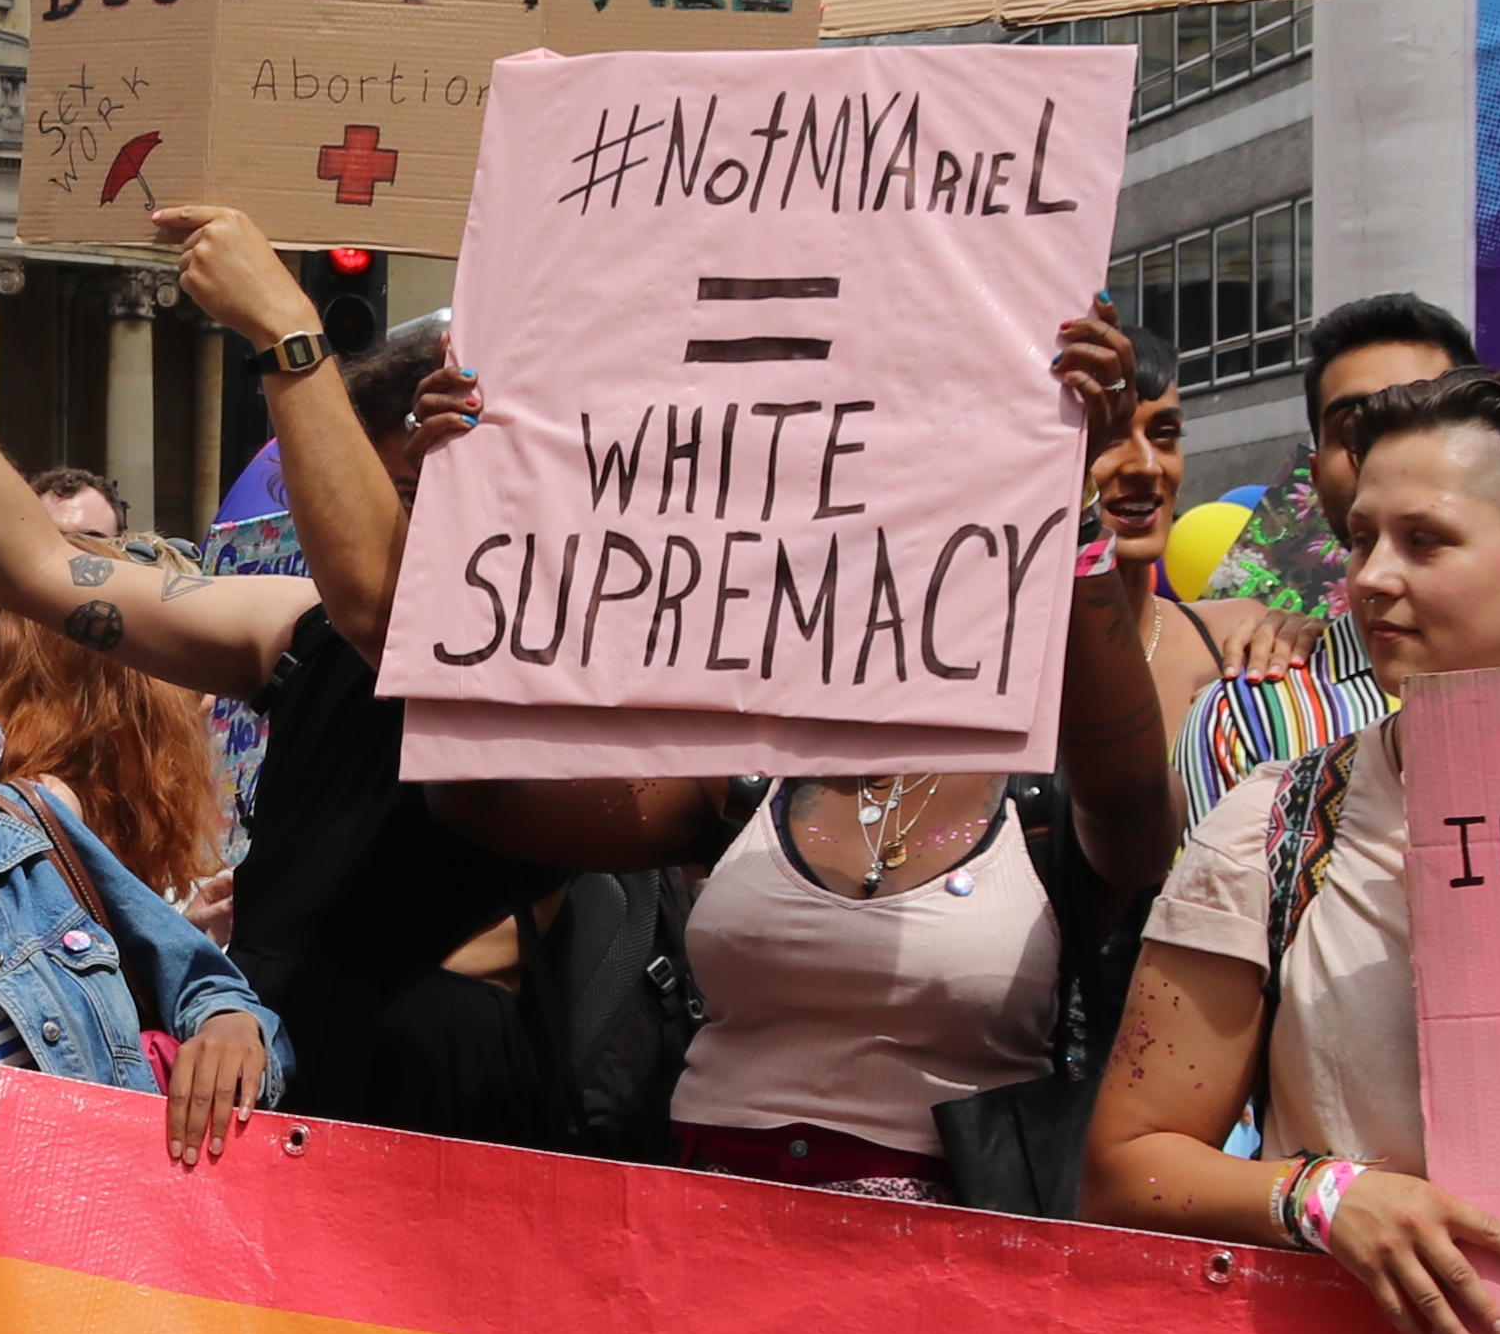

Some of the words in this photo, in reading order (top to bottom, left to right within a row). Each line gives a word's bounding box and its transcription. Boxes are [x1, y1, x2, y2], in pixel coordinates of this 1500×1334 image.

[48, 66, 150, 193] WORK
[581, 400, 876, 520] WHITE
[432, 507, 1068, 696] SUPREMACY
